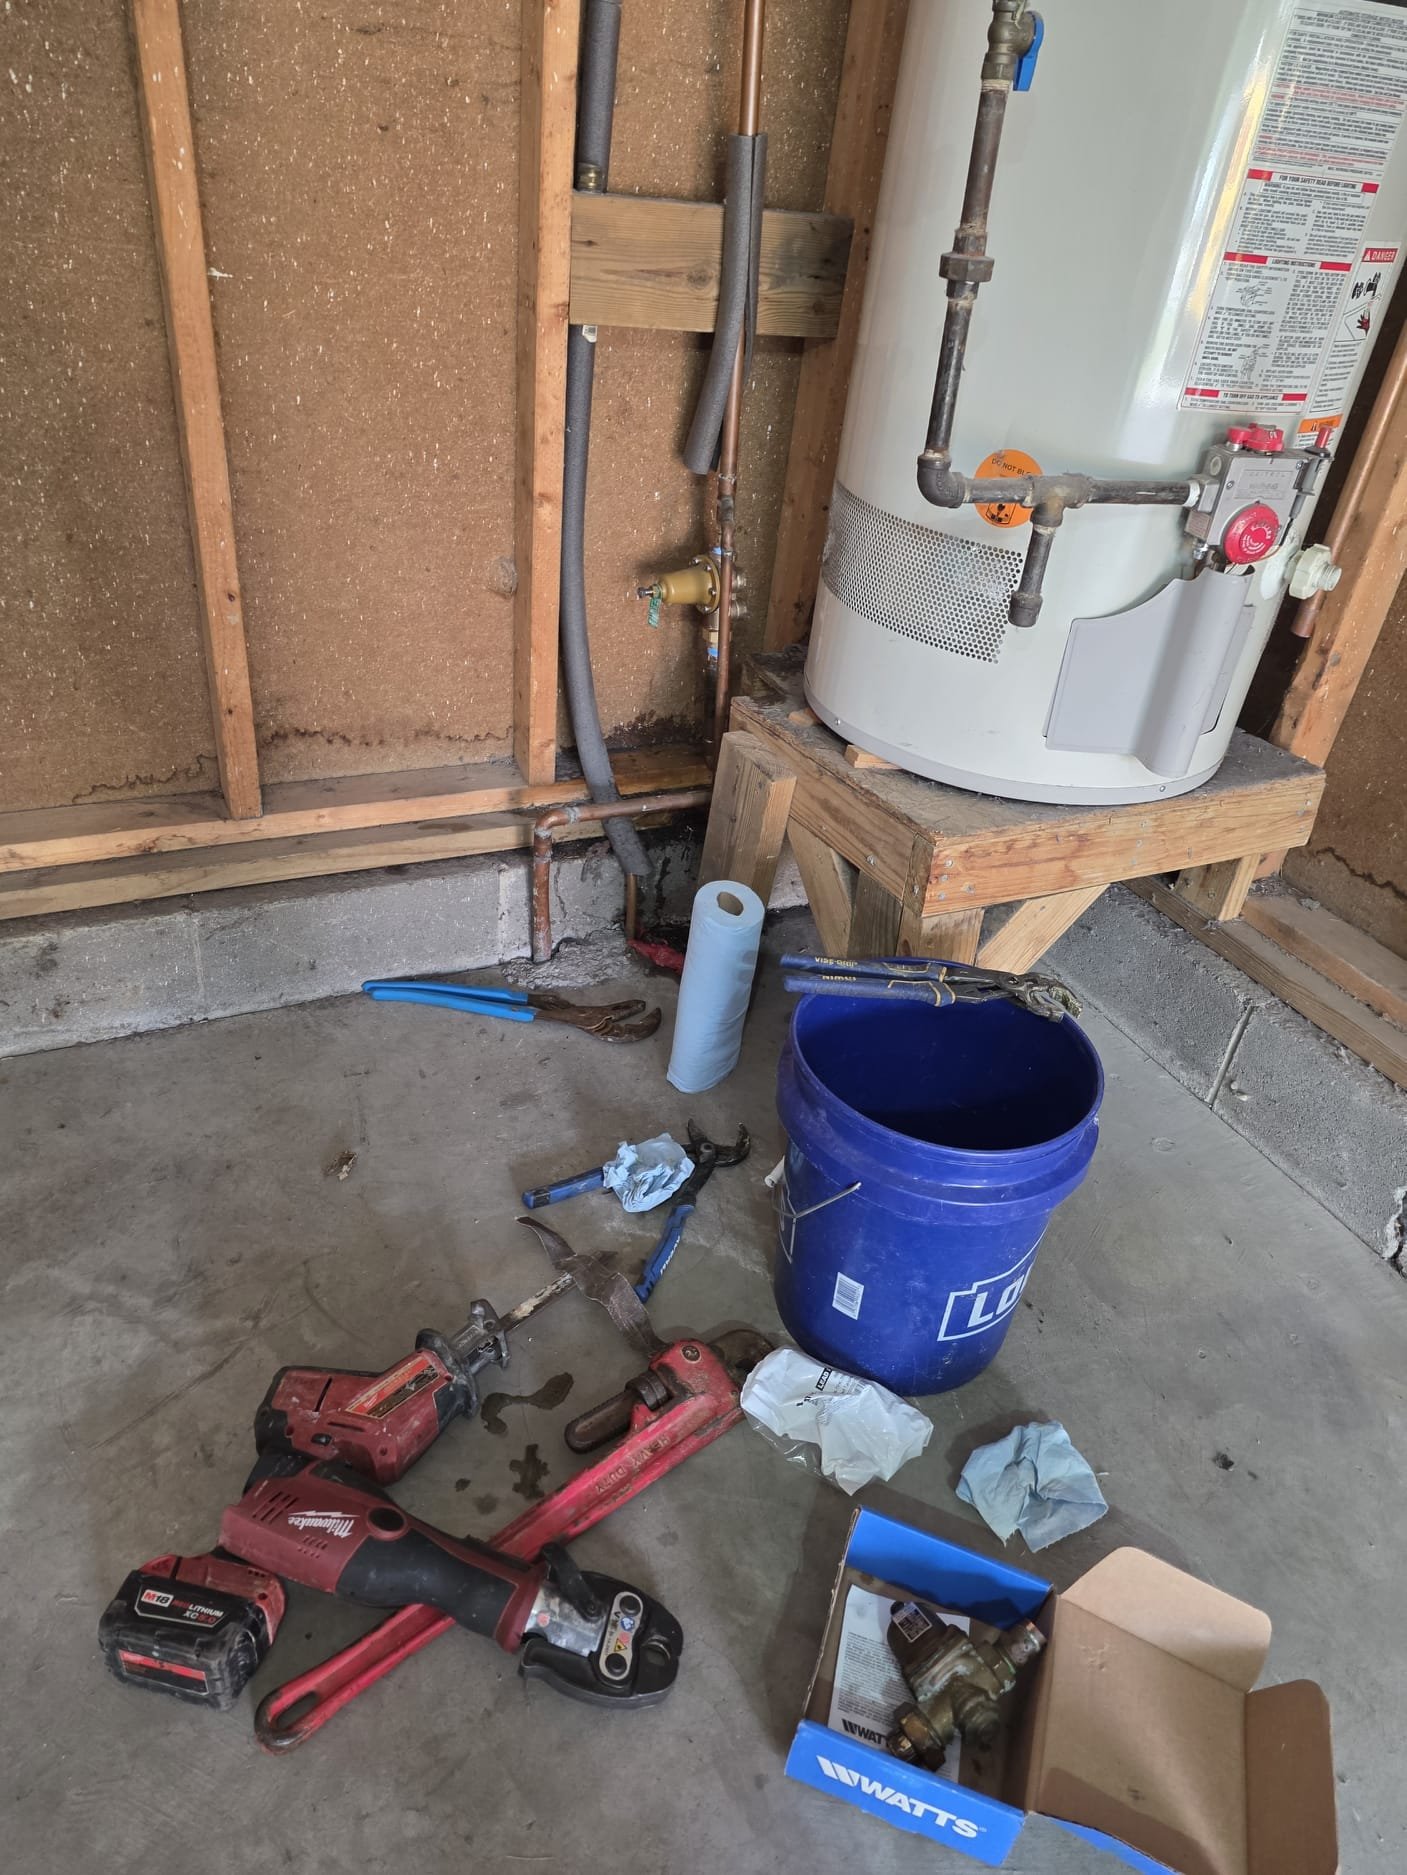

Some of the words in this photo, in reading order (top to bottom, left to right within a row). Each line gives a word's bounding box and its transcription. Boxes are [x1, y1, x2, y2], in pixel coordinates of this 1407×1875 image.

[1300, 177, 1316, 185] SAFETY
[1371, 251, 1396, 262] DANGER
[991, 458, 1001, 466] DO
[1002, 462, 1017, 472] NOT
[967, 1274, 1025, 1329] LO
[817, 1371, 831, 1389] LEAD
[287, 1516, 355, 1539] Milwaukee
[142, 1591, 171, 1605] M18
[857, 1774, 979, 1839] WATTS
